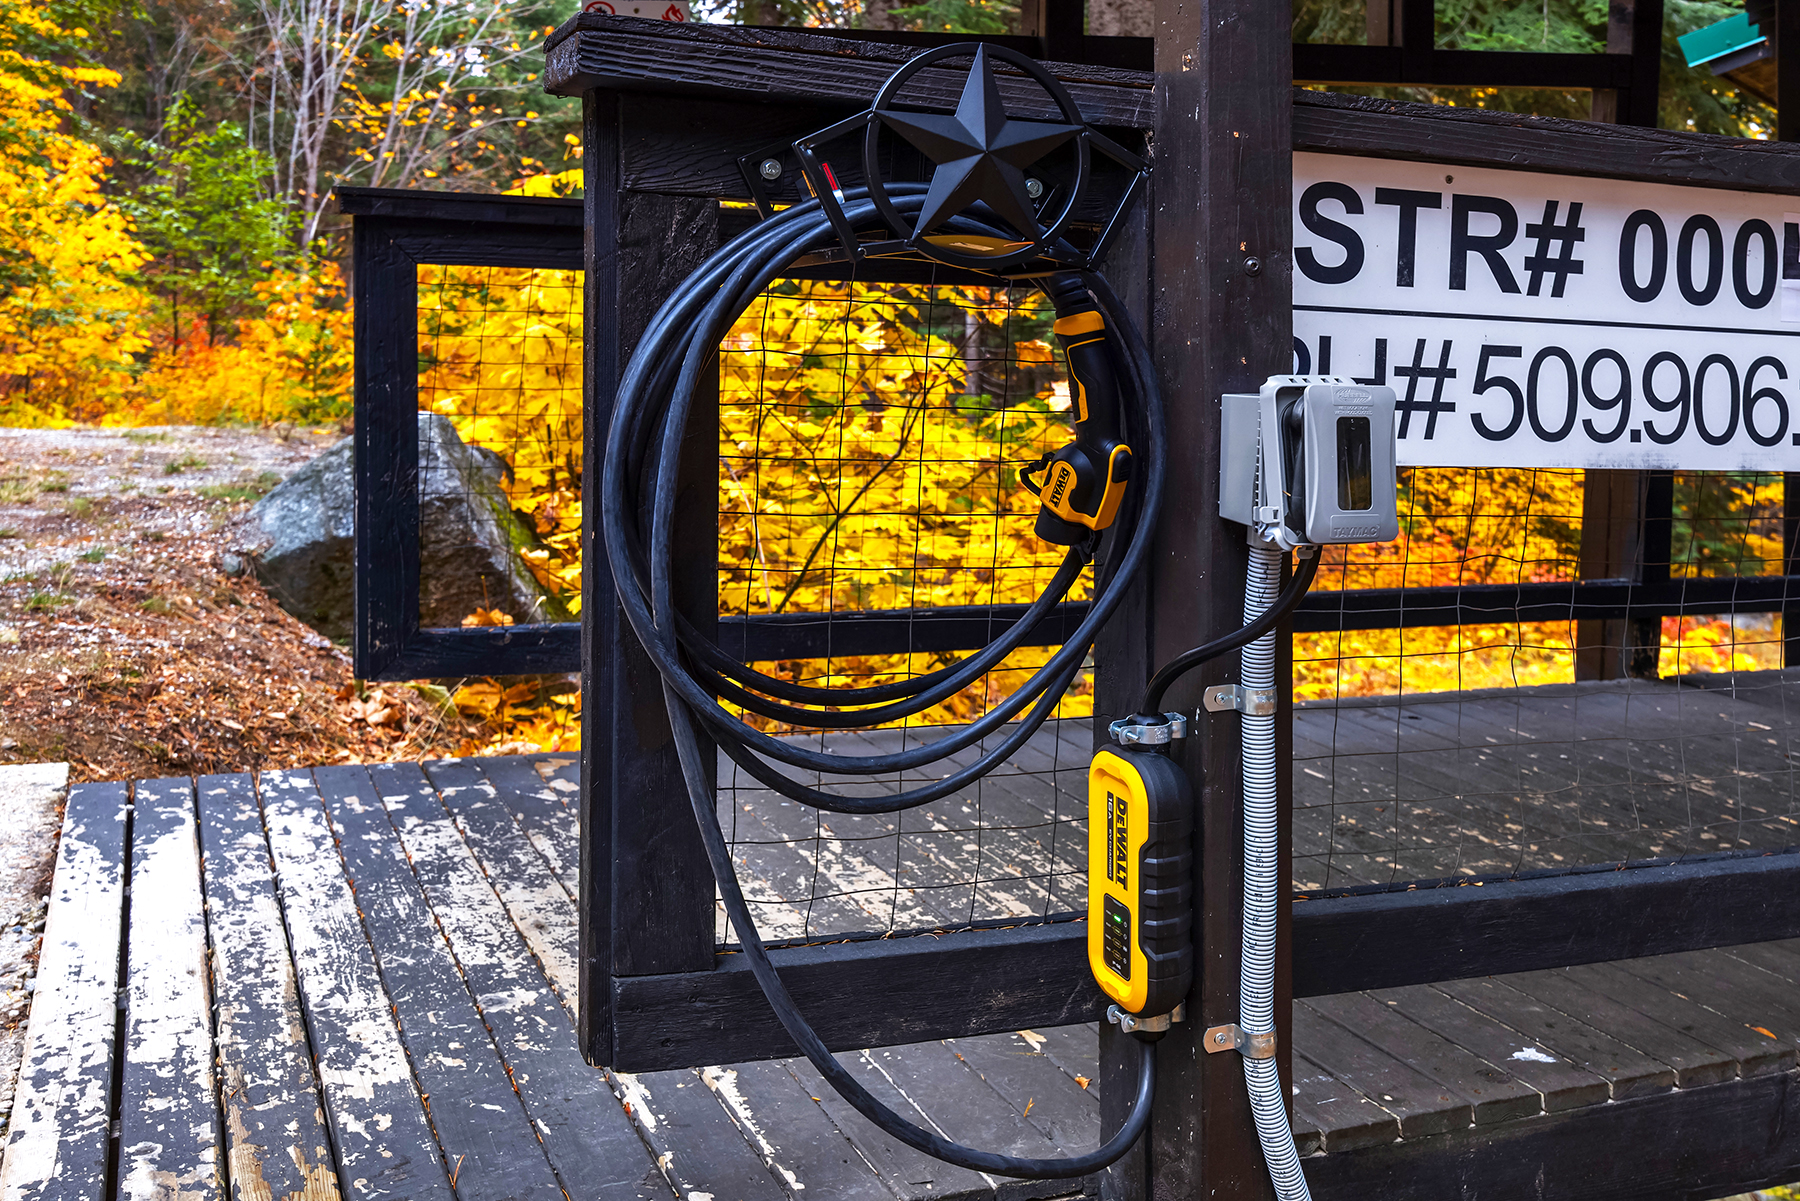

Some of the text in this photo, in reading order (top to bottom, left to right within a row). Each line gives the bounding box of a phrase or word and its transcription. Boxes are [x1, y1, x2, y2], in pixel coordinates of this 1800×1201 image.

[1293, 181, 1585, 298] STR#
[1050, 467, 1070, 508] DEWALT
[1333, 526, 1378, 538] TAYMAC
[1116, 796, 1128, 891] DEWALT
